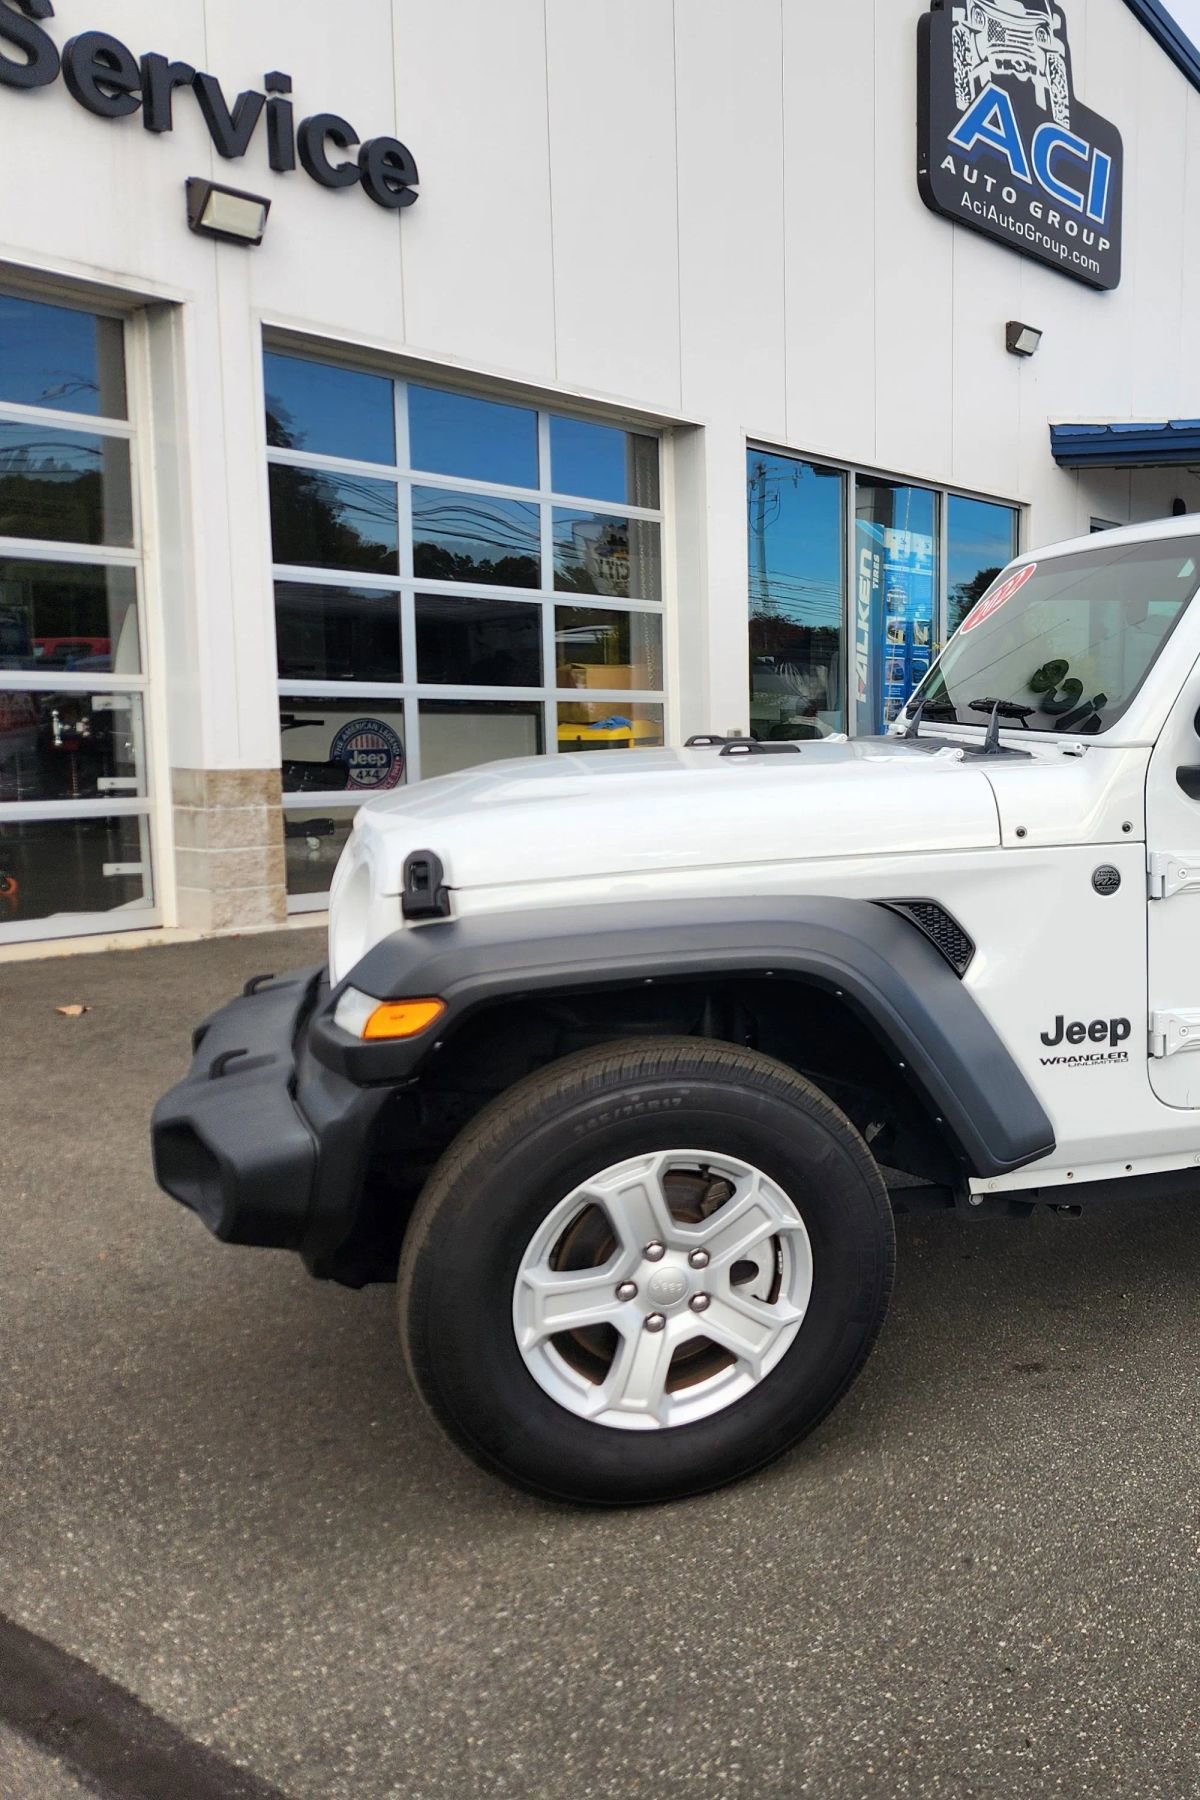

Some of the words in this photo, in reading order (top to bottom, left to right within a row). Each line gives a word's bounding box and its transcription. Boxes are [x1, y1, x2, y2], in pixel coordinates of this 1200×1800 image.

[0, 0, 419, 208] Service
[947, 81, 1112, 224] ACI
[940, 155, 1017, 203] AUTO
[1029, 203, 1111, 251] GROUP
[960, 191, 1101, 274] AciAutoGroup.com
[872, 554, 880, 589] TIRES
[855, 548, 873, 703] FALKEN
[349, 750, 387, 767] Jeep
[1040, 1015, 1131, 1047] Jeep
[1040, 1051, 1129, 1066] WRANGLER
[1067, 1057, 1129, 1067] UNLIMITED
